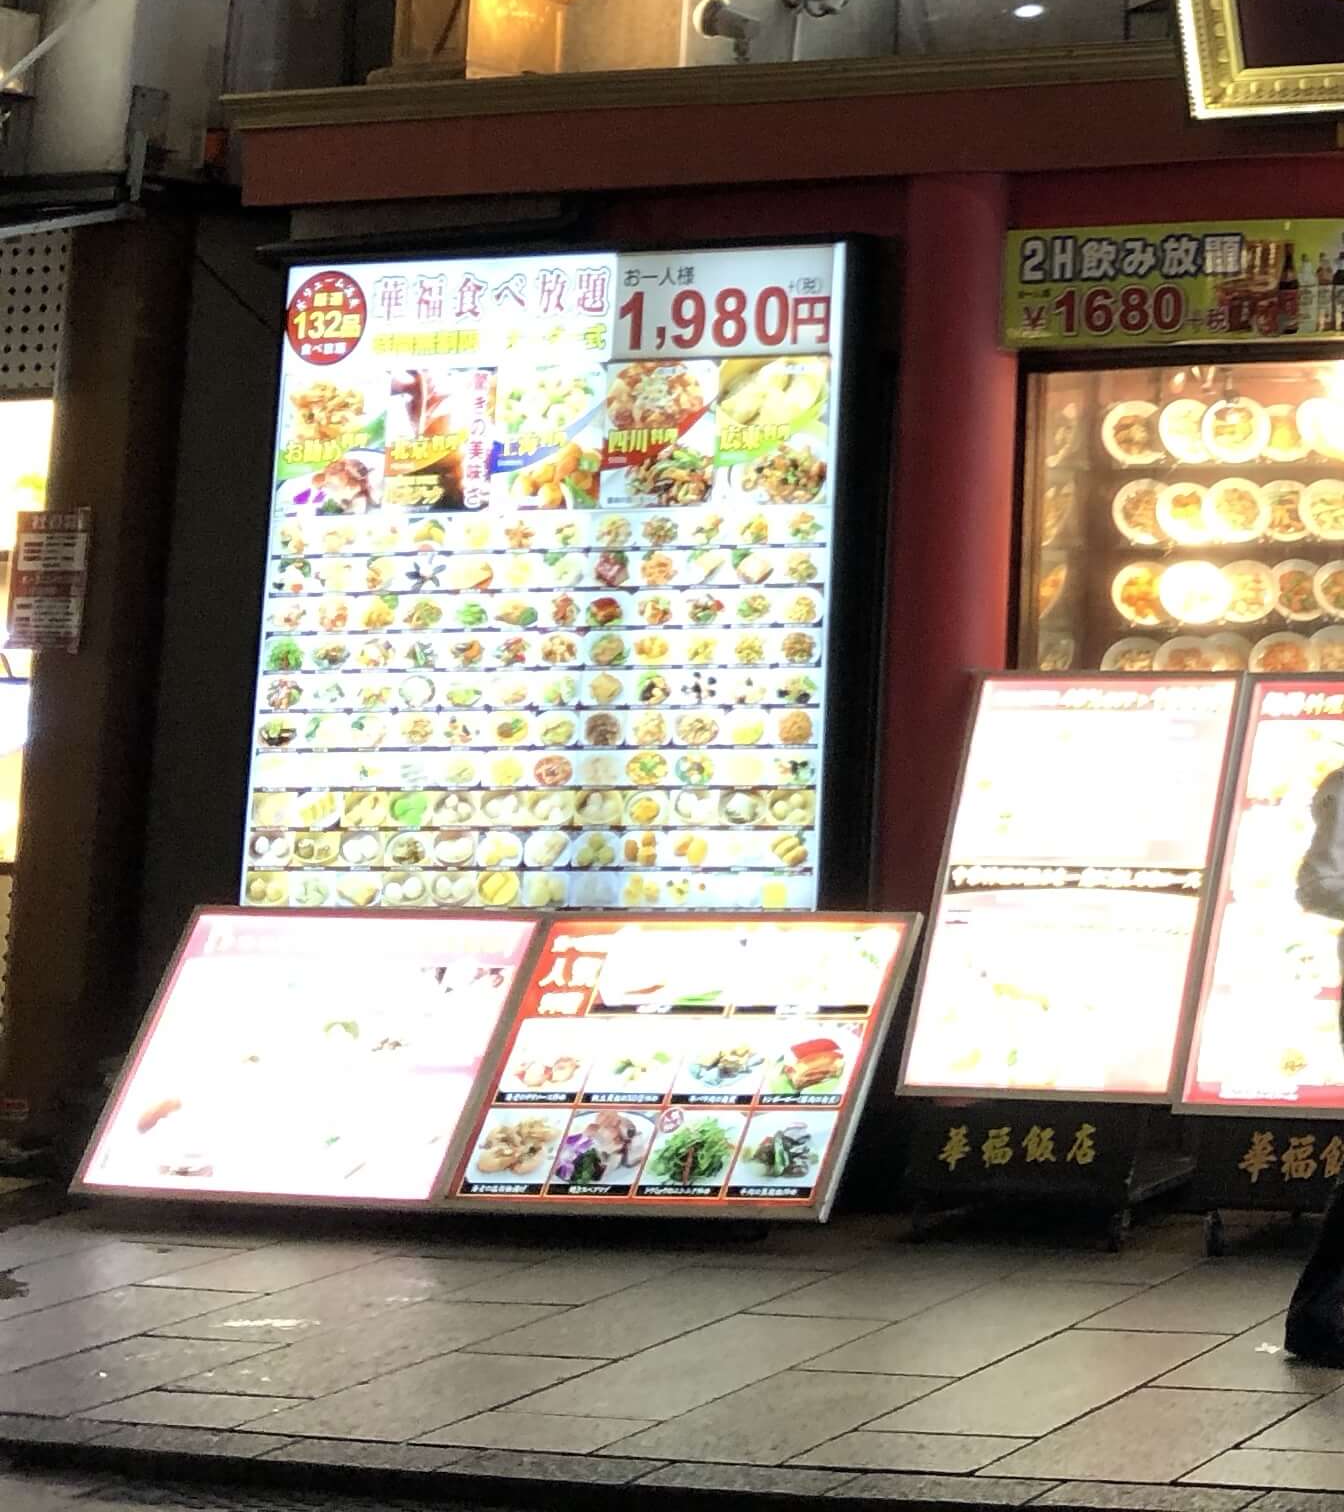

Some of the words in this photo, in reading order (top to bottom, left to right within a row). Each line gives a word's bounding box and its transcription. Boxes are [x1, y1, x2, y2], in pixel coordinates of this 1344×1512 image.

[624, 267, 695, 287] お一人様
[1020, 232, 1246, 284] 2H飲み放題
[376, 269, 611, 321] 華福食べ放題
[619, 286, 830, 350] 1,980円
[937, 1123, 1097, 1172] 華福飯店
